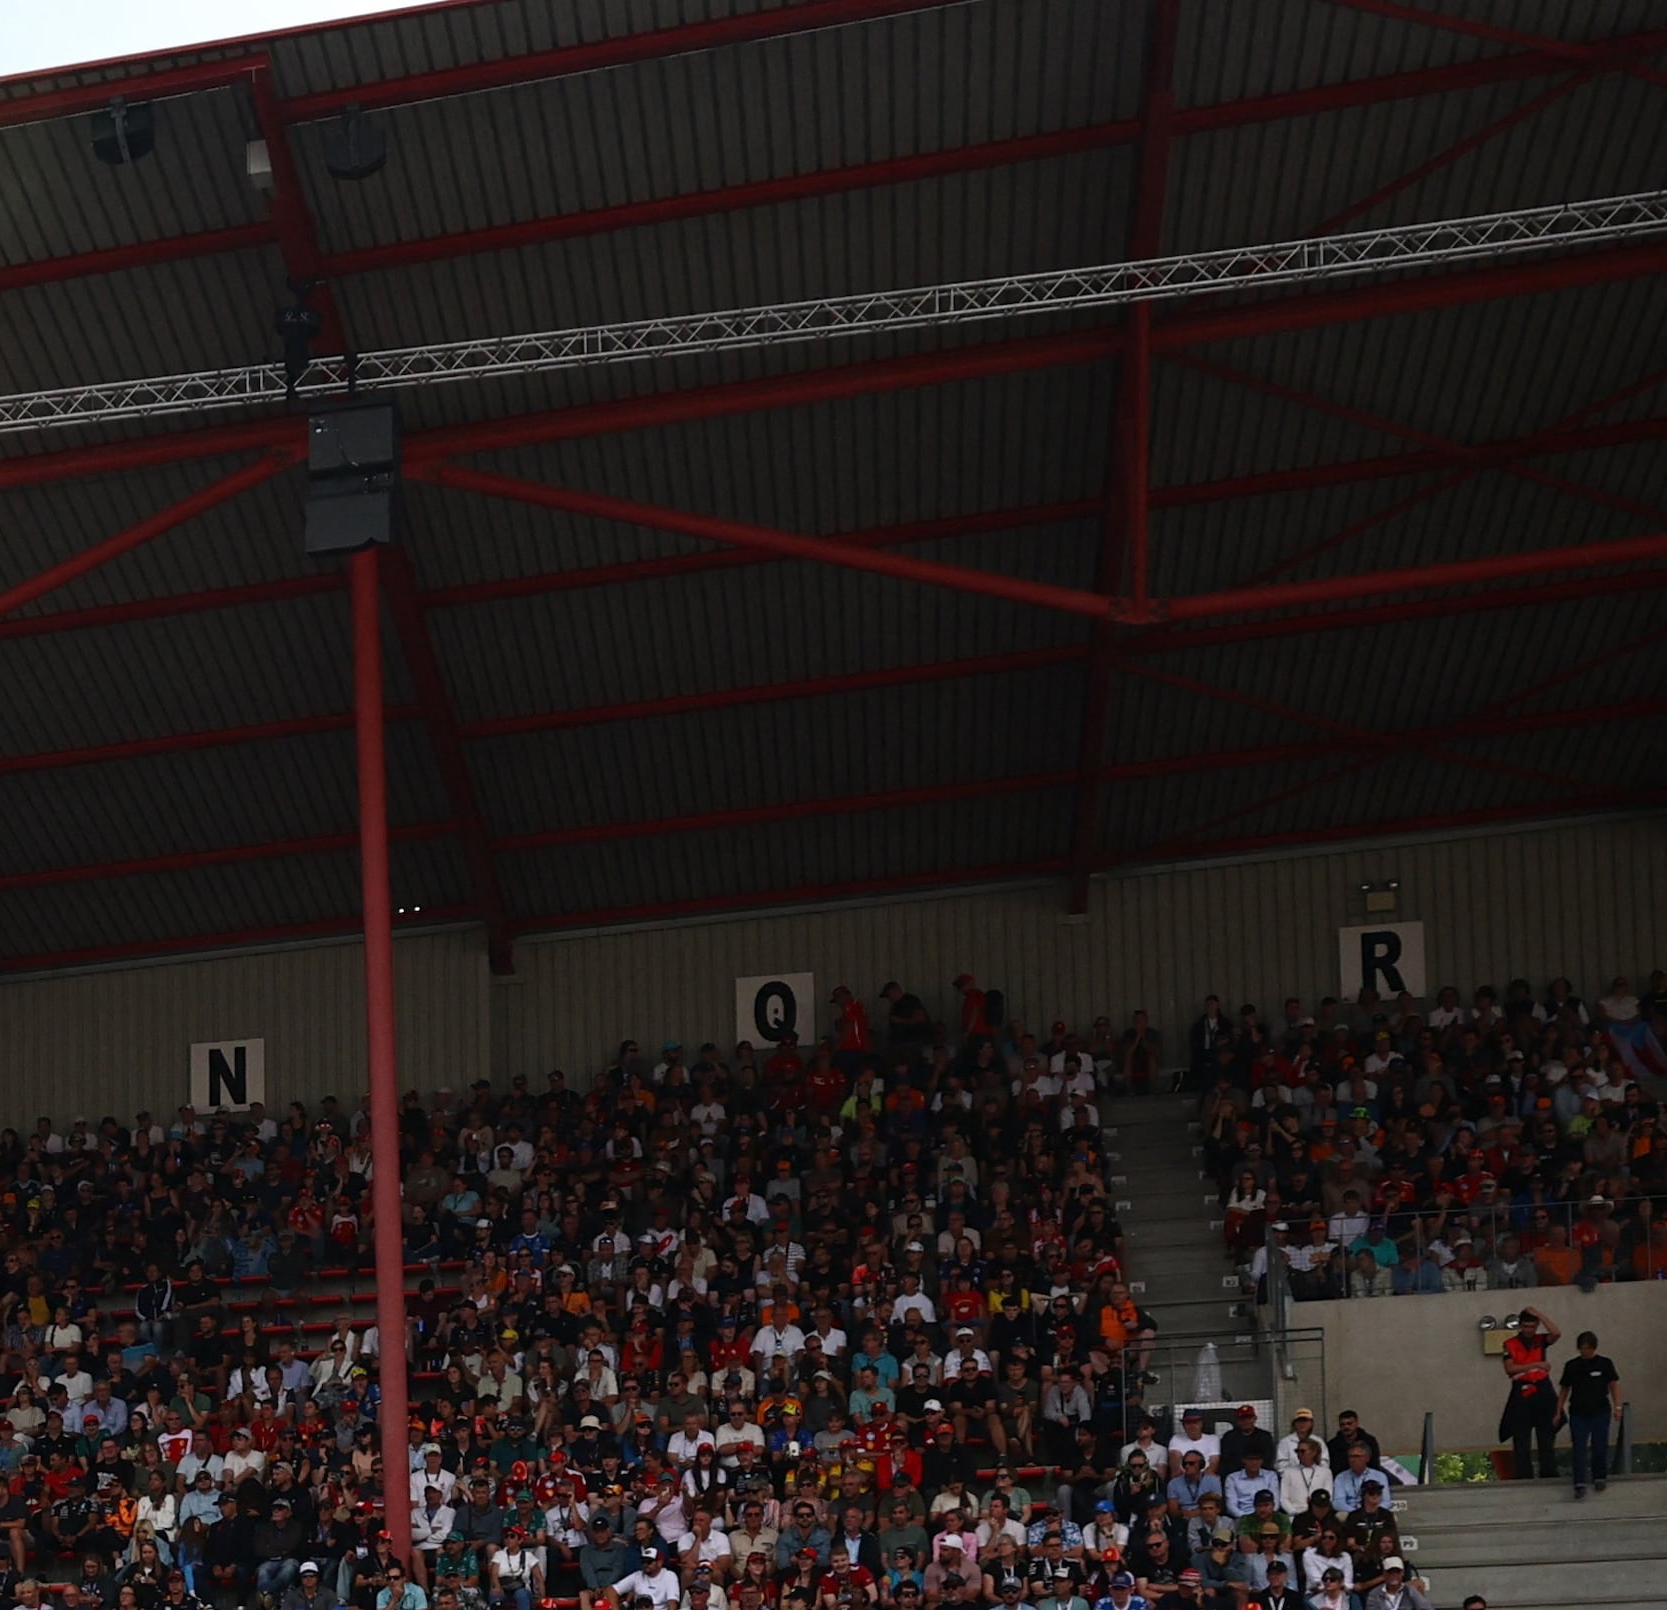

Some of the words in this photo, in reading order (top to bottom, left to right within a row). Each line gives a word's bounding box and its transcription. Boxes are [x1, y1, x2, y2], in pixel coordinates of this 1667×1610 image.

[1366, 931, 1405, 994] R
[754, 981, 797, 1041] Q
[208, 1046, 246, 1106] N
